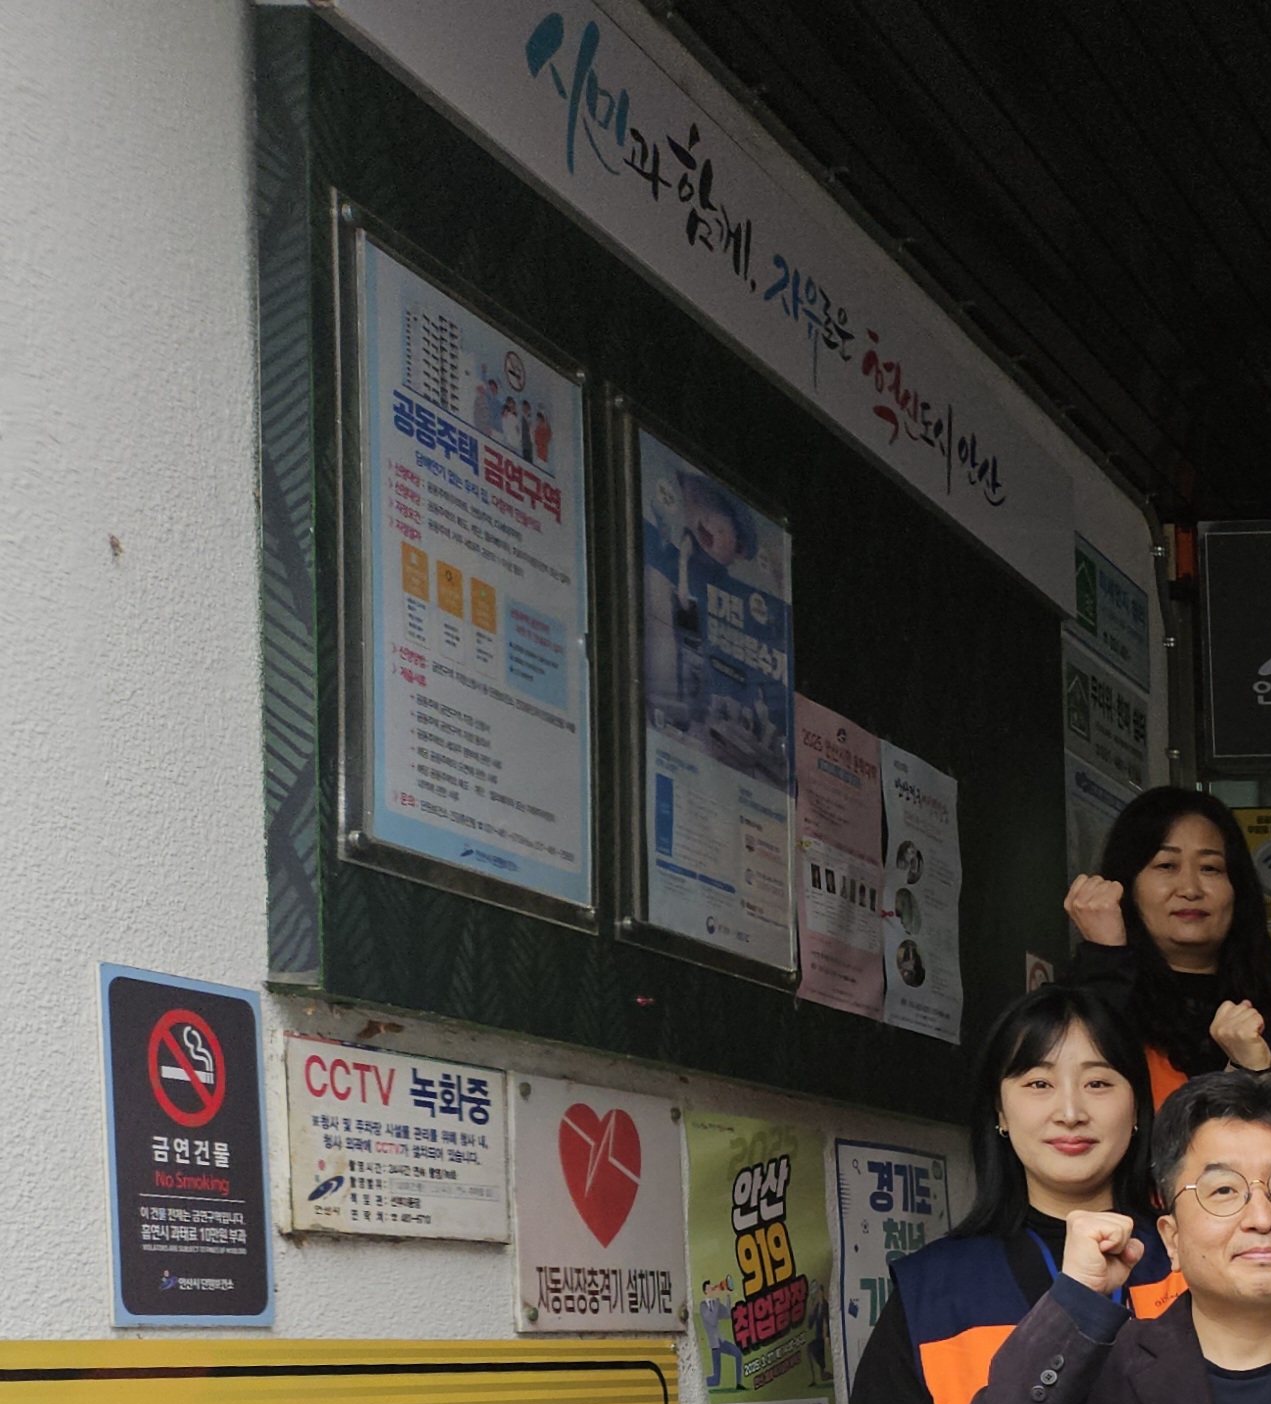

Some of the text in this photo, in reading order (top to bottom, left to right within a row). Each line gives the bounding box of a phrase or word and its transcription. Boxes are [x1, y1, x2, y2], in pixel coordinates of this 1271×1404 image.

[393, 389, 479, 476] 공동주택
[484, 445, 561, 524] 금연구역
[958, 432, 1005, 506] 안산
[304, 1054, 492, 1126] CCTV 녹화중
[152, 1135, 230, 1168] 금연건물
[155, 1170, 230, 1196] No Smoking
[867, 1160, 932, 1215] 경기도
[732, 1157, 789, 1231] 안산
[141, 1224, 247, 1244] 흡연시 과태료 10만원 부과
[735, 1219, 796, 1298] 919
[536, 1265, 673, 1316] 자동심장충격기 설치기관
[731, 1274, 808, 1354] 취업광장
